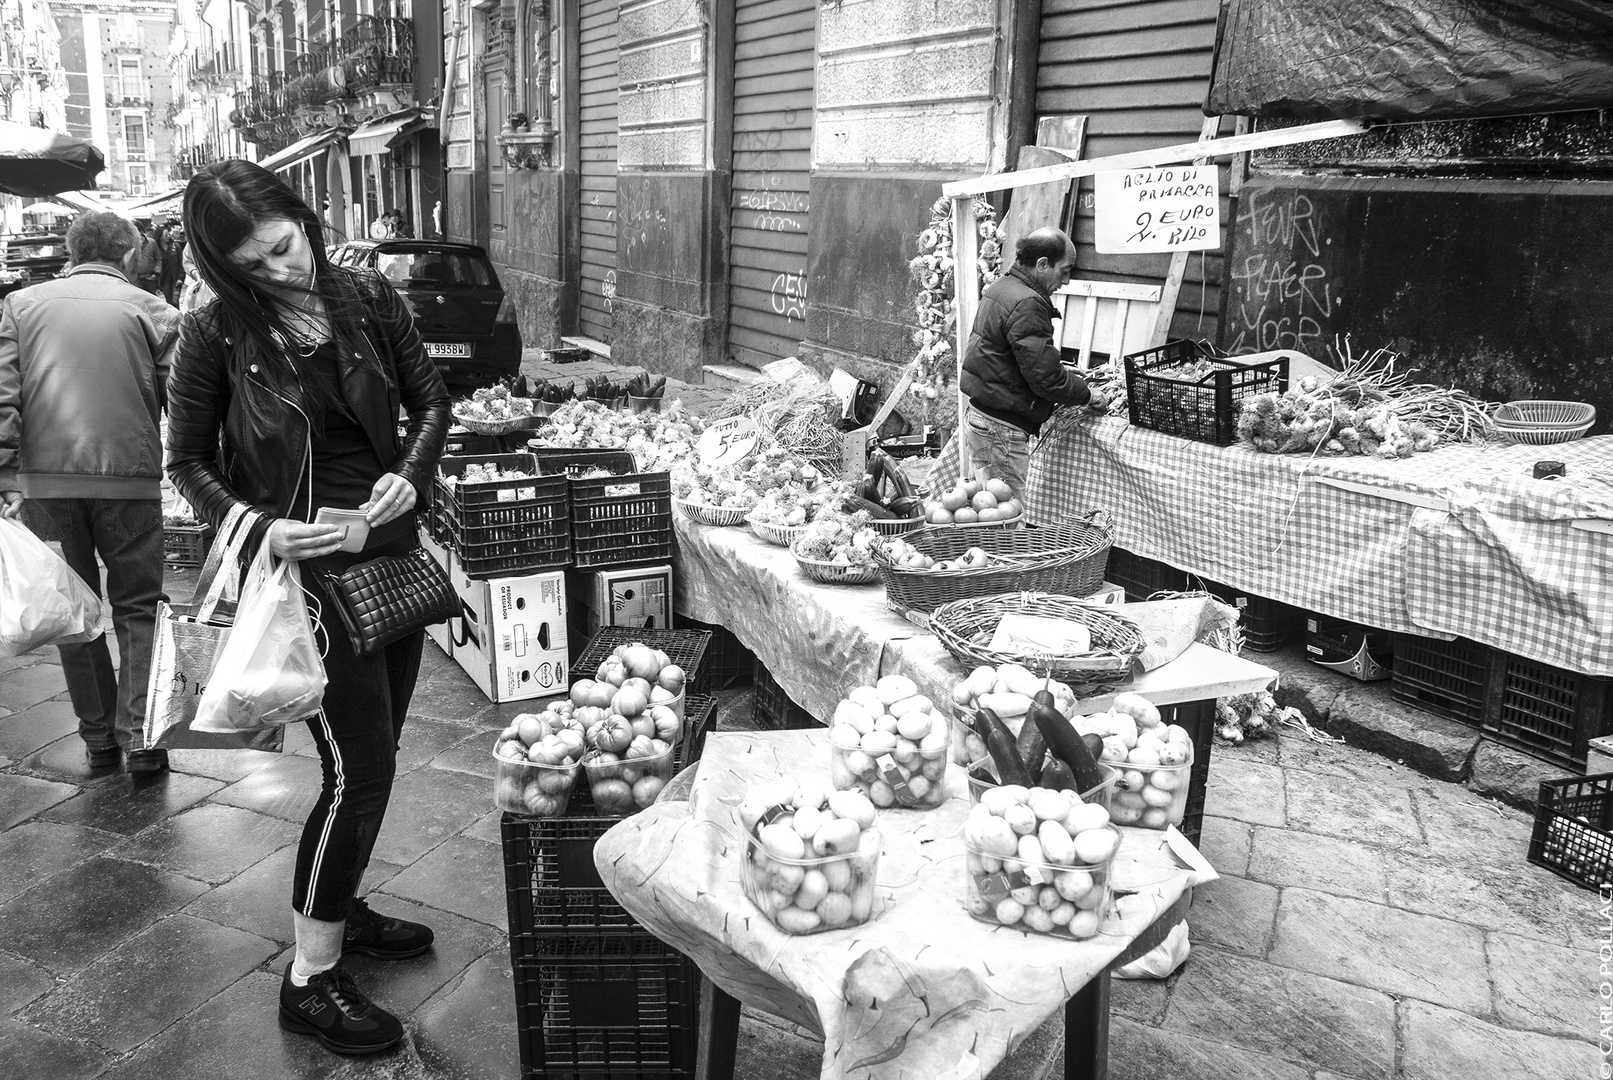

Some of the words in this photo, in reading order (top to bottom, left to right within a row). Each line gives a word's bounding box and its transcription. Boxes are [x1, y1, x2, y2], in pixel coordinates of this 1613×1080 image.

[1123, 169, 1173, 189] AGLIO
[1182, 168, 1199, 182] DI
[1159, 204, 1214, 224] EURO
[434, 344, 464, 355] 993BW
[714, 420, 739, 433] TUTTO
[731, 430, 755, 443] EURO
